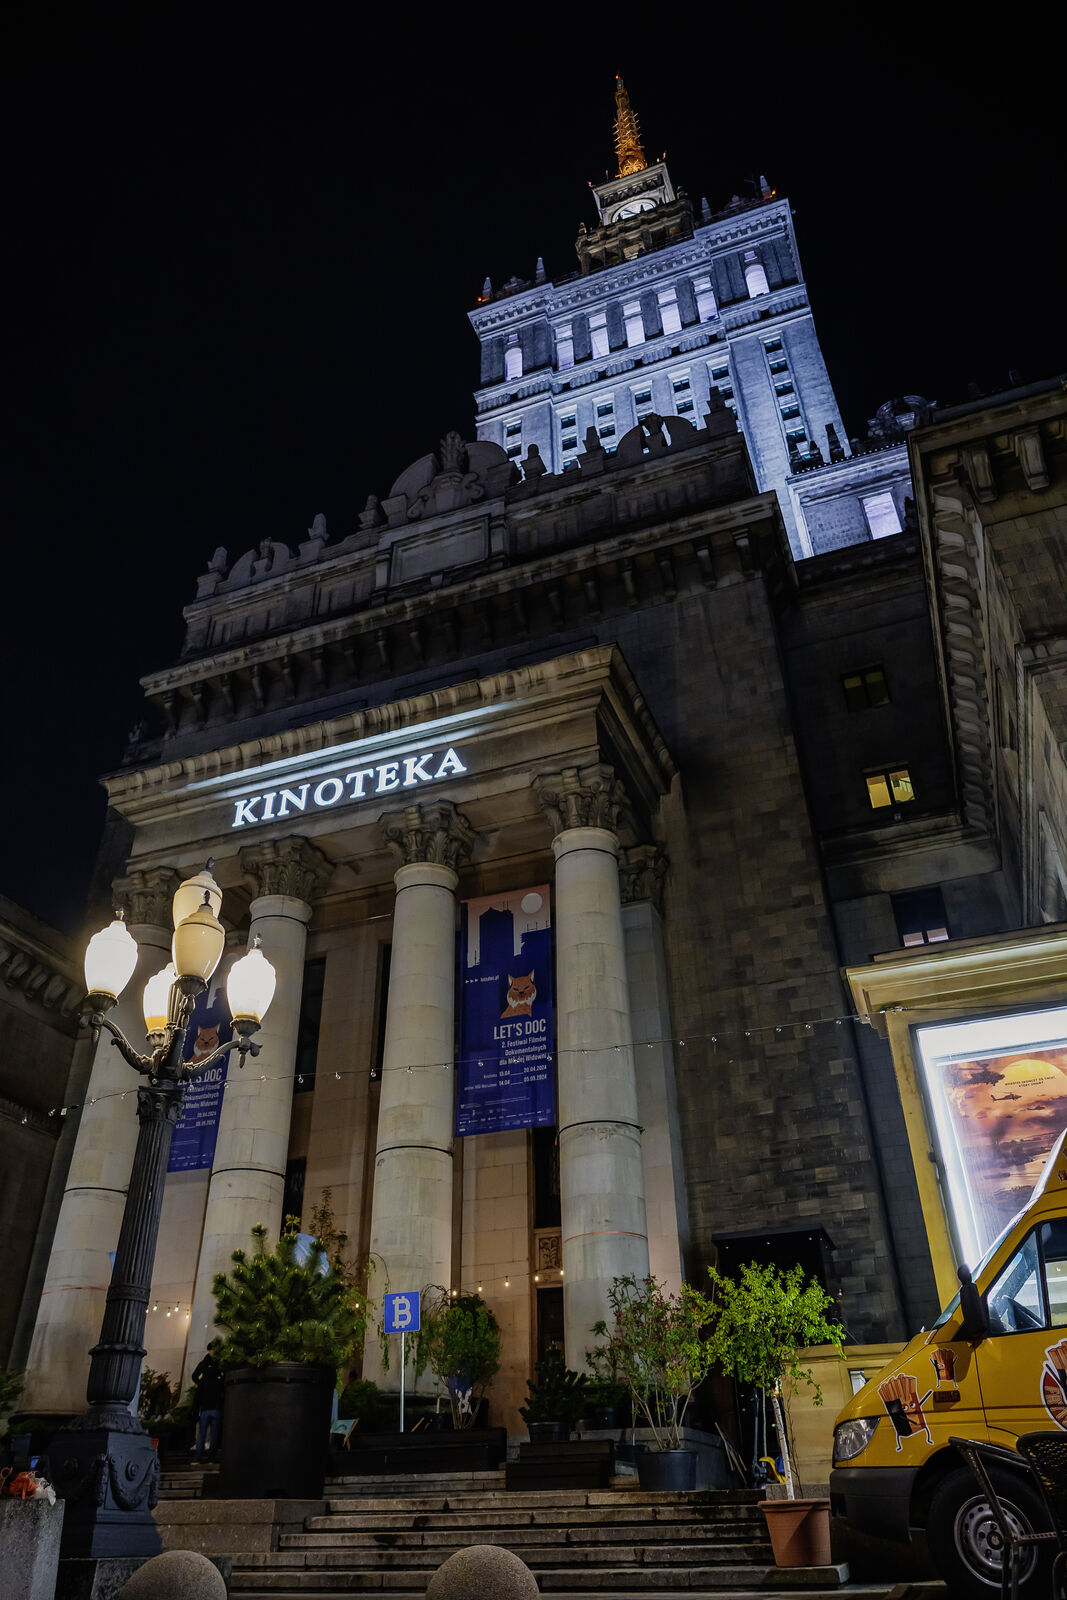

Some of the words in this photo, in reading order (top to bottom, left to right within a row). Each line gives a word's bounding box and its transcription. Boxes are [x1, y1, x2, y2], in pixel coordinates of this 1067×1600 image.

[231, 747, 467, 828] KINOTEKA
[493, 1022, 523, 1040] LET'S
[525, 1018, 547, 1035] DOC
[507, 1038, 528, 1048] Festiwal
